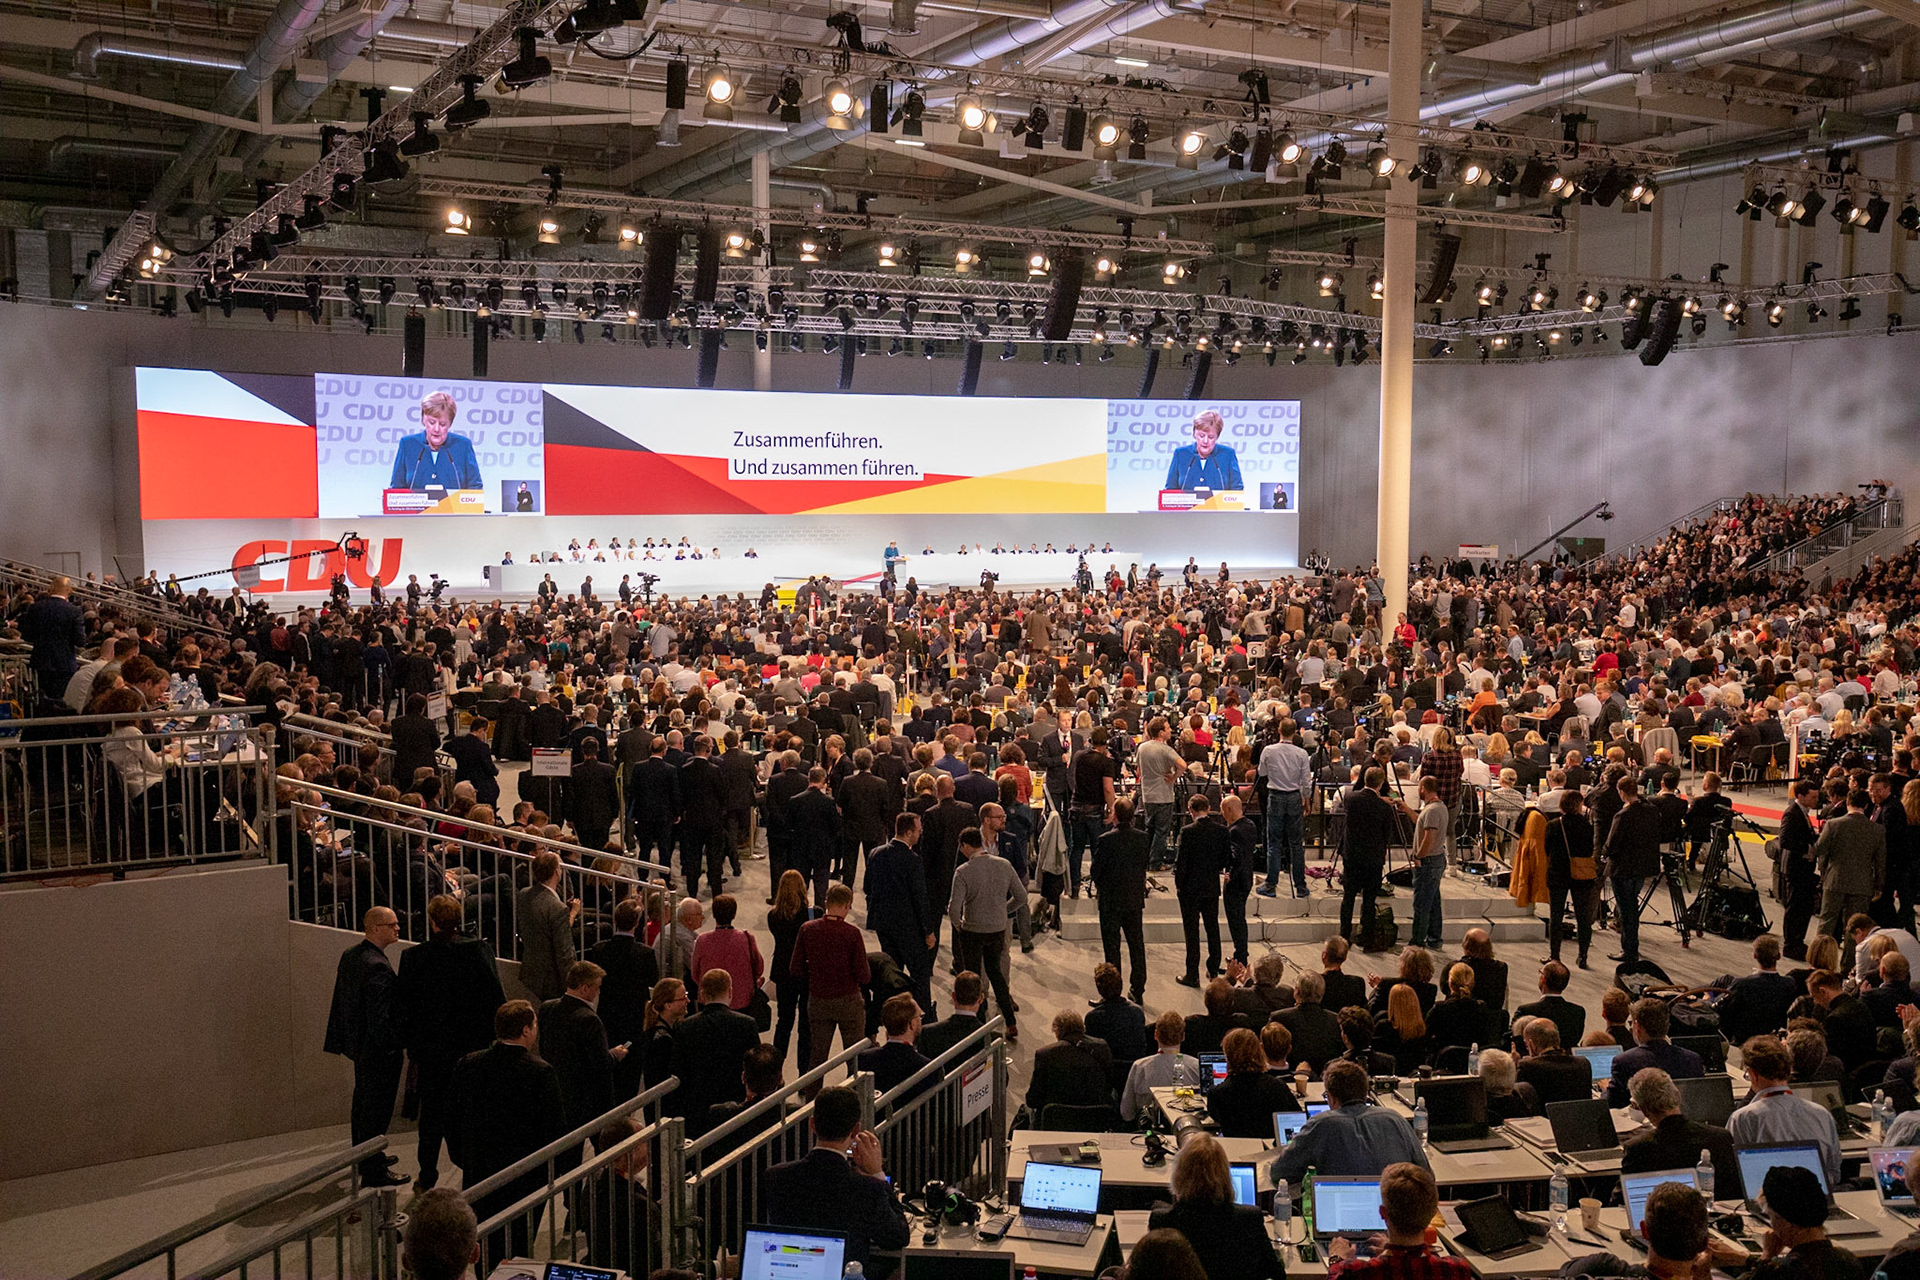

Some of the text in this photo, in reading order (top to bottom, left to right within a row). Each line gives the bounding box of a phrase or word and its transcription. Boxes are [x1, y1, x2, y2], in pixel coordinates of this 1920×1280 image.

[374, 382, 424, 400] CDU
[496, 388, 541, 404] CDU
[343, 403, 394, 421] CDU
[466, 408, 514, 425] CDU
[1155, 404, 1196, 418] CDU
[1258, 405, 1299, 419] CDU
[1128, 422, 1170, 435] CDU
[1232, 423, 1273, 436] CDU
[733, 430, 883, 448] Zusammenführen.
[345, 449, 395, 466] CDU
[733, 458, 919, 476] Und zusammen führen.
[231, 538, 403, 594] CDU
[1250, 645, 1258, 656] 6
[967, 1084, 990, 1108] Presse
